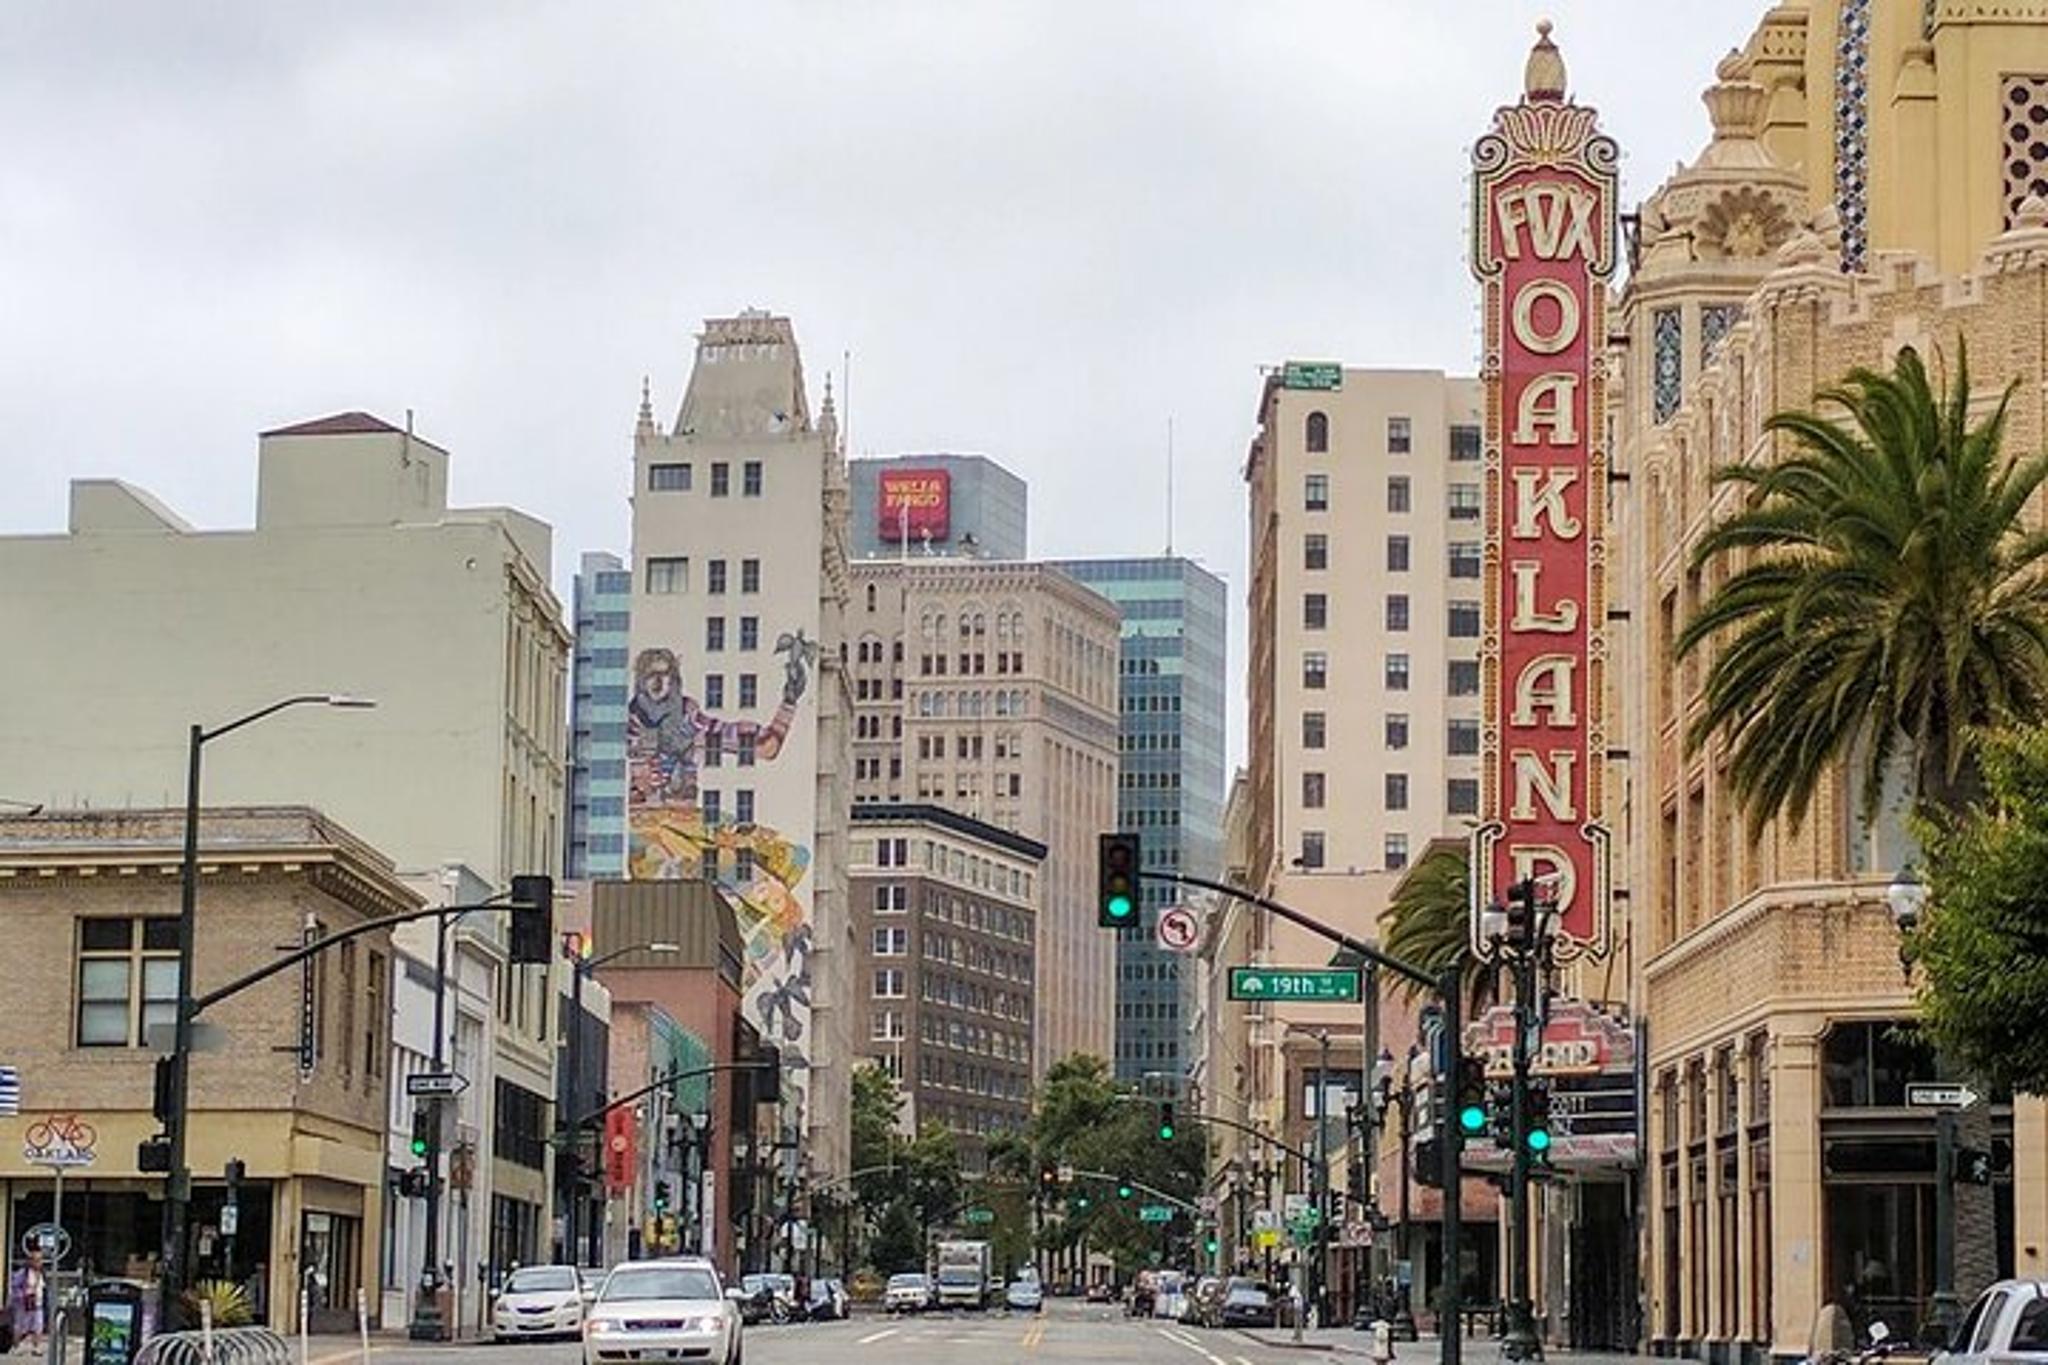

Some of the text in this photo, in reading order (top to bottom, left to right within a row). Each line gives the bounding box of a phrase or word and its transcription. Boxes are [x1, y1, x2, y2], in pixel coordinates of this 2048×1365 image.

[1496, 182, 1597, 259] FOX
[884, 480, 941, 493] WELLS
[1511, 278, 1579, 917] OAKLAND
[1271, 976, 1315, 993] 19th
